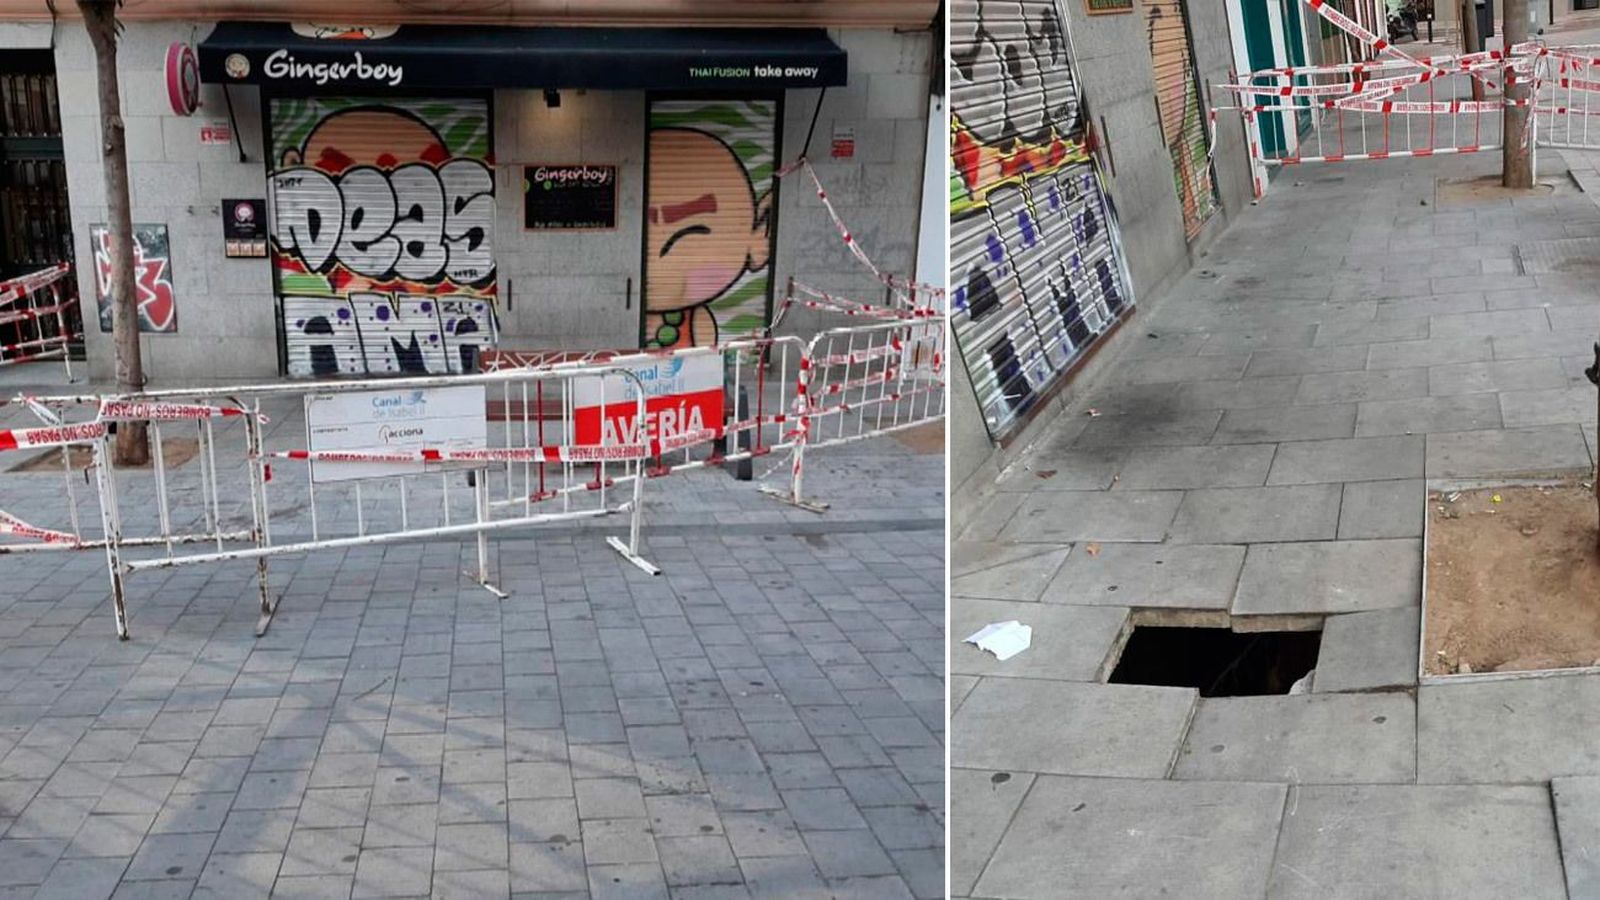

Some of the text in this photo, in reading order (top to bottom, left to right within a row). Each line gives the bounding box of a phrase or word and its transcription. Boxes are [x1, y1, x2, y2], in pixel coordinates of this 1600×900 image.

[264, 49, 403, 85] Gingerboy
[689, 64, 818, 79] THAI FUSION take away
[534, 167, 607, 183] Gingerboy
[372, 395, 402, 407] Canal
[136, 403, 150, 418] NO
[155, 404, 211, 418] BOMBEROS
[601, 399, 705, 446] AVERÍA
[27, 429, 60, 445] PASAR
[62, 426, 78, 441] NO
[389, 428, 424, 438] acciona
